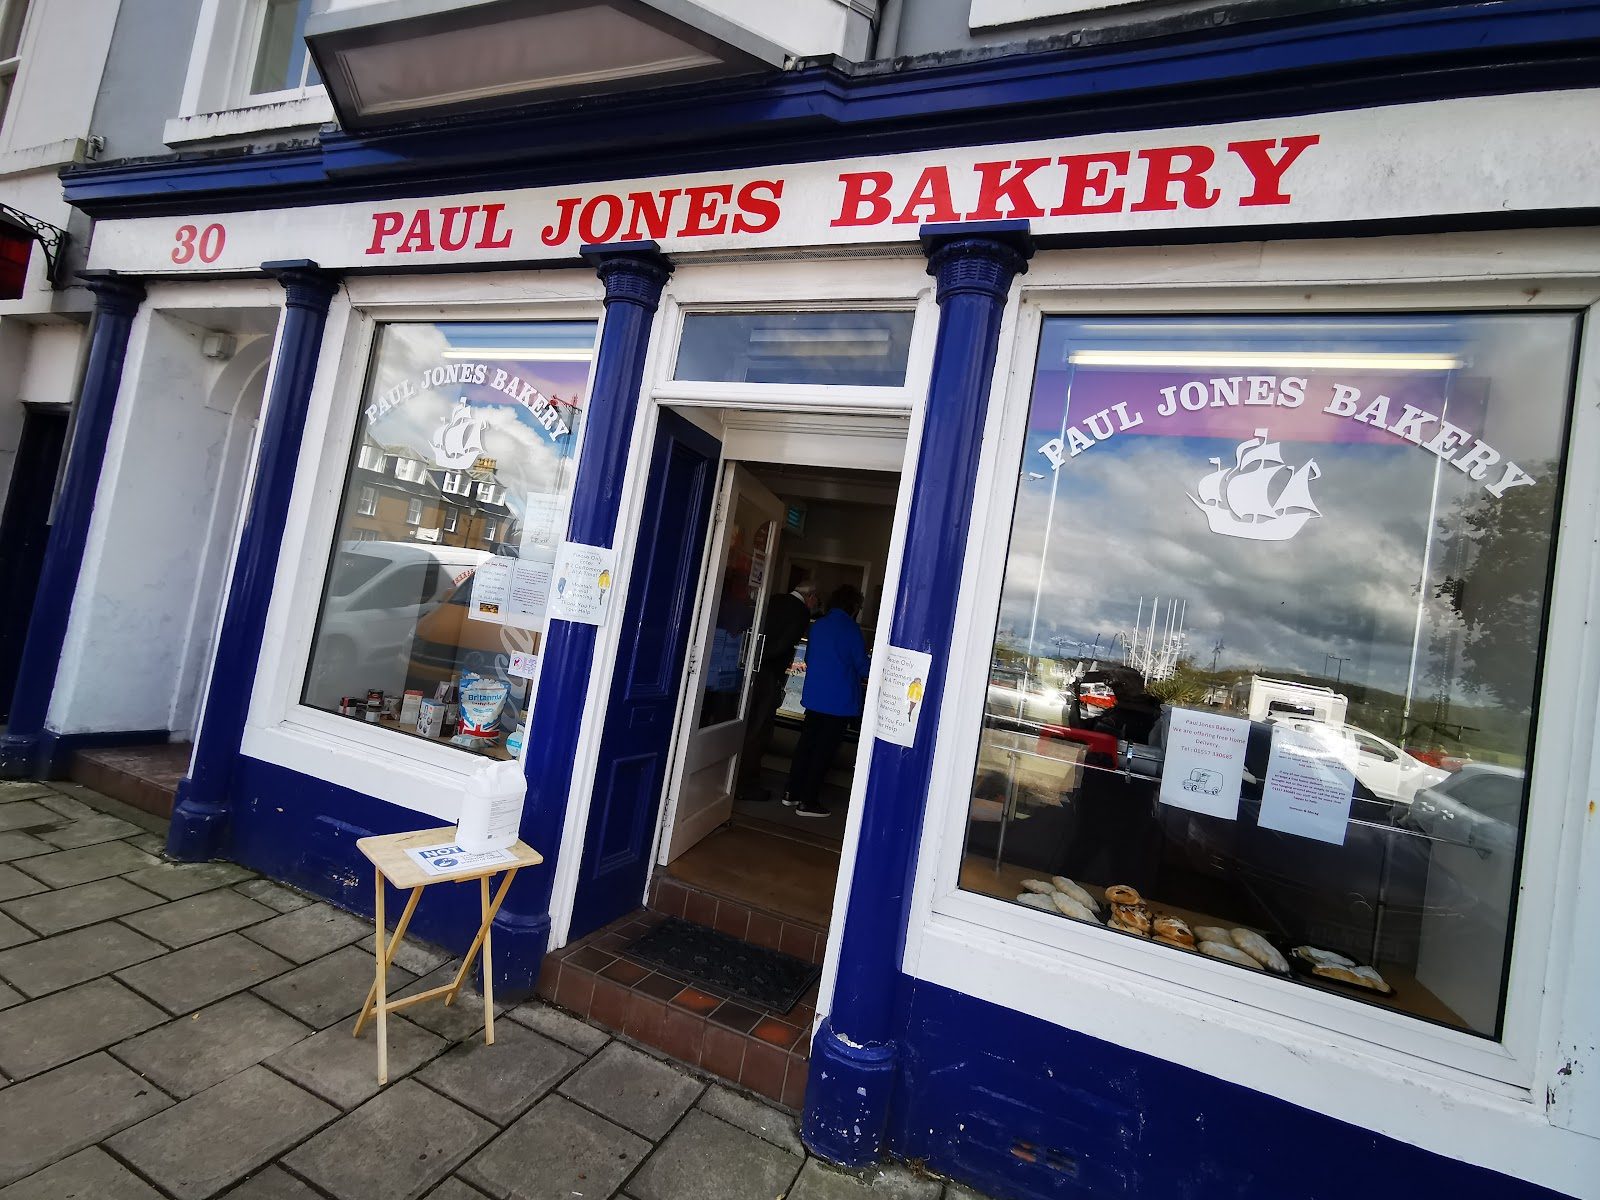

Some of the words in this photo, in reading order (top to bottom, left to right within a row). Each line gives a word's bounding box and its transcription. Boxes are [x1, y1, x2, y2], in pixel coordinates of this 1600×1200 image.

[365, 203, 513, 255] PAUL
[541, 179, 785, 247] JONES
[830, 134, 1320, 227] BAKERY
[172, 223, 226, 264] 30
[365, 379, 417, 425] PAUL
[421, 364, 488, 389] JONES
[490, 368, 571, 442] BAKERY
[1038, 400, 1144, 471] PAUL
[1157, 376, 1309, 418] JONES
[1324, 383, 1537, 500] BAKERY
[1194, 730, 1216, 739] offering
[1216, 725, 1236, 733] Bakery
